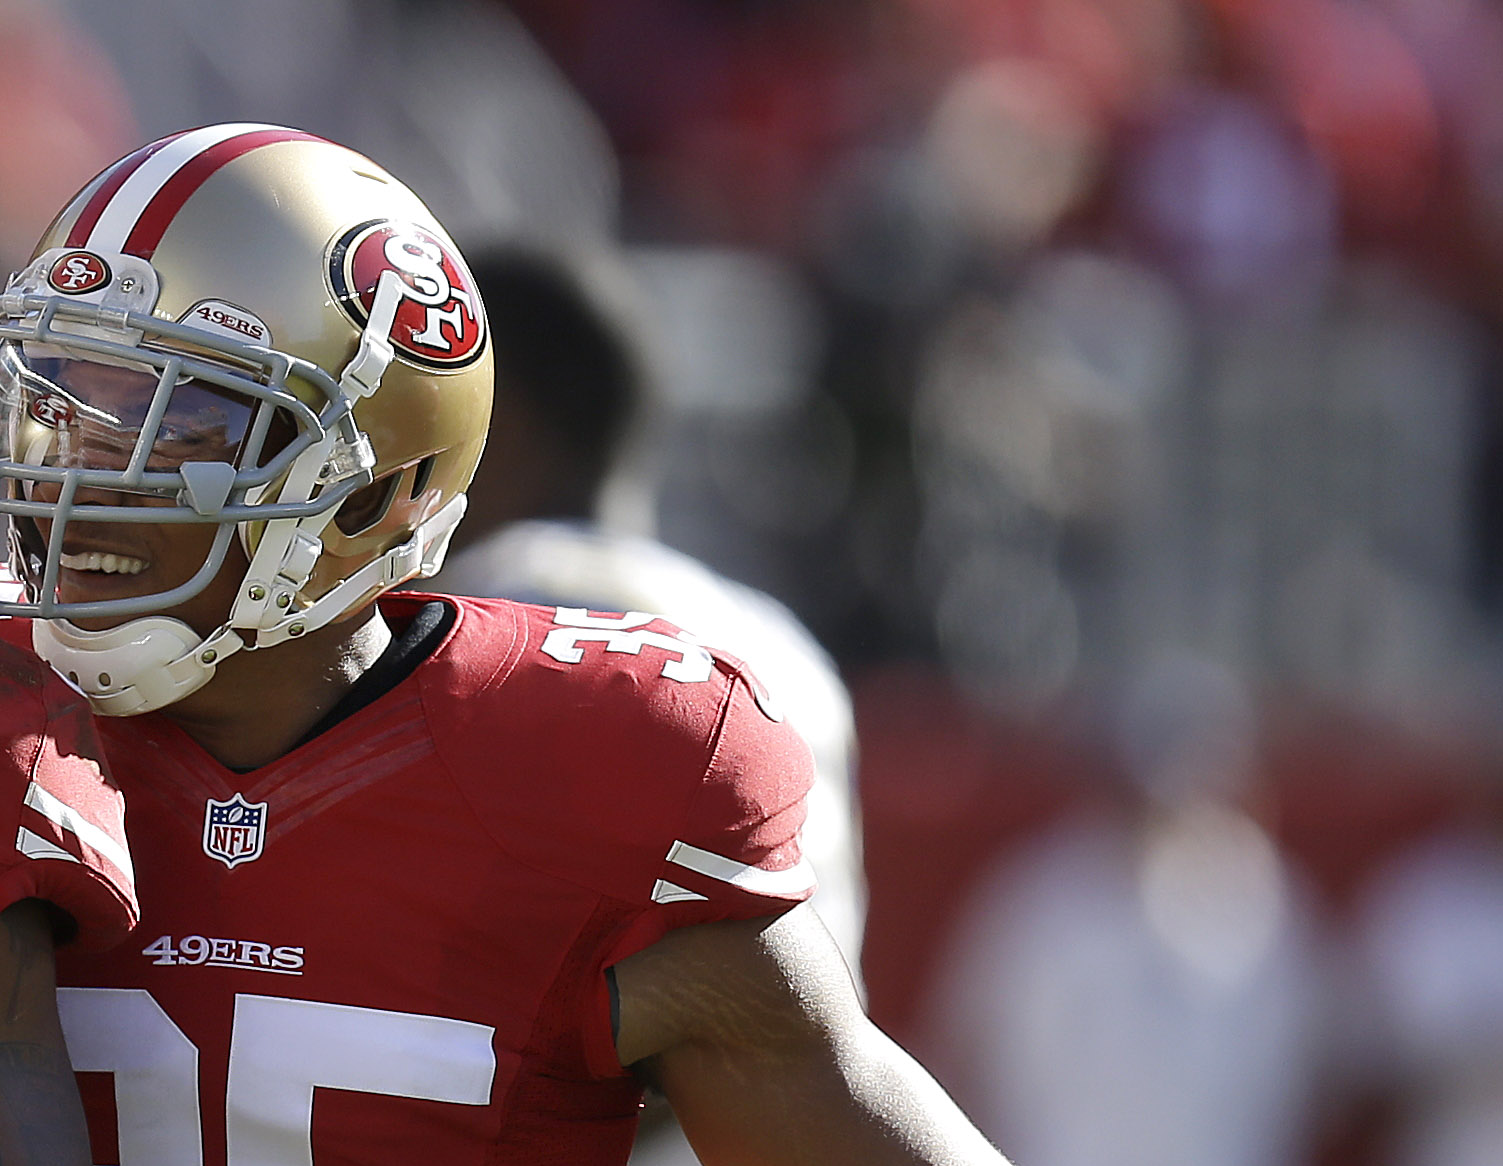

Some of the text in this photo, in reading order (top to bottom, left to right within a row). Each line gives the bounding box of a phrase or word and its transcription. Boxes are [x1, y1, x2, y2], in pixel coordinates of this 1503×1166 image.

[62, 257, 97, 288] SF
[384, 234, 474, 351] SF
[197, 307, 264, 341] 49ERS
[213, 826, 254, 856] NFL
[142, 935, 305, 975] 49ERS
